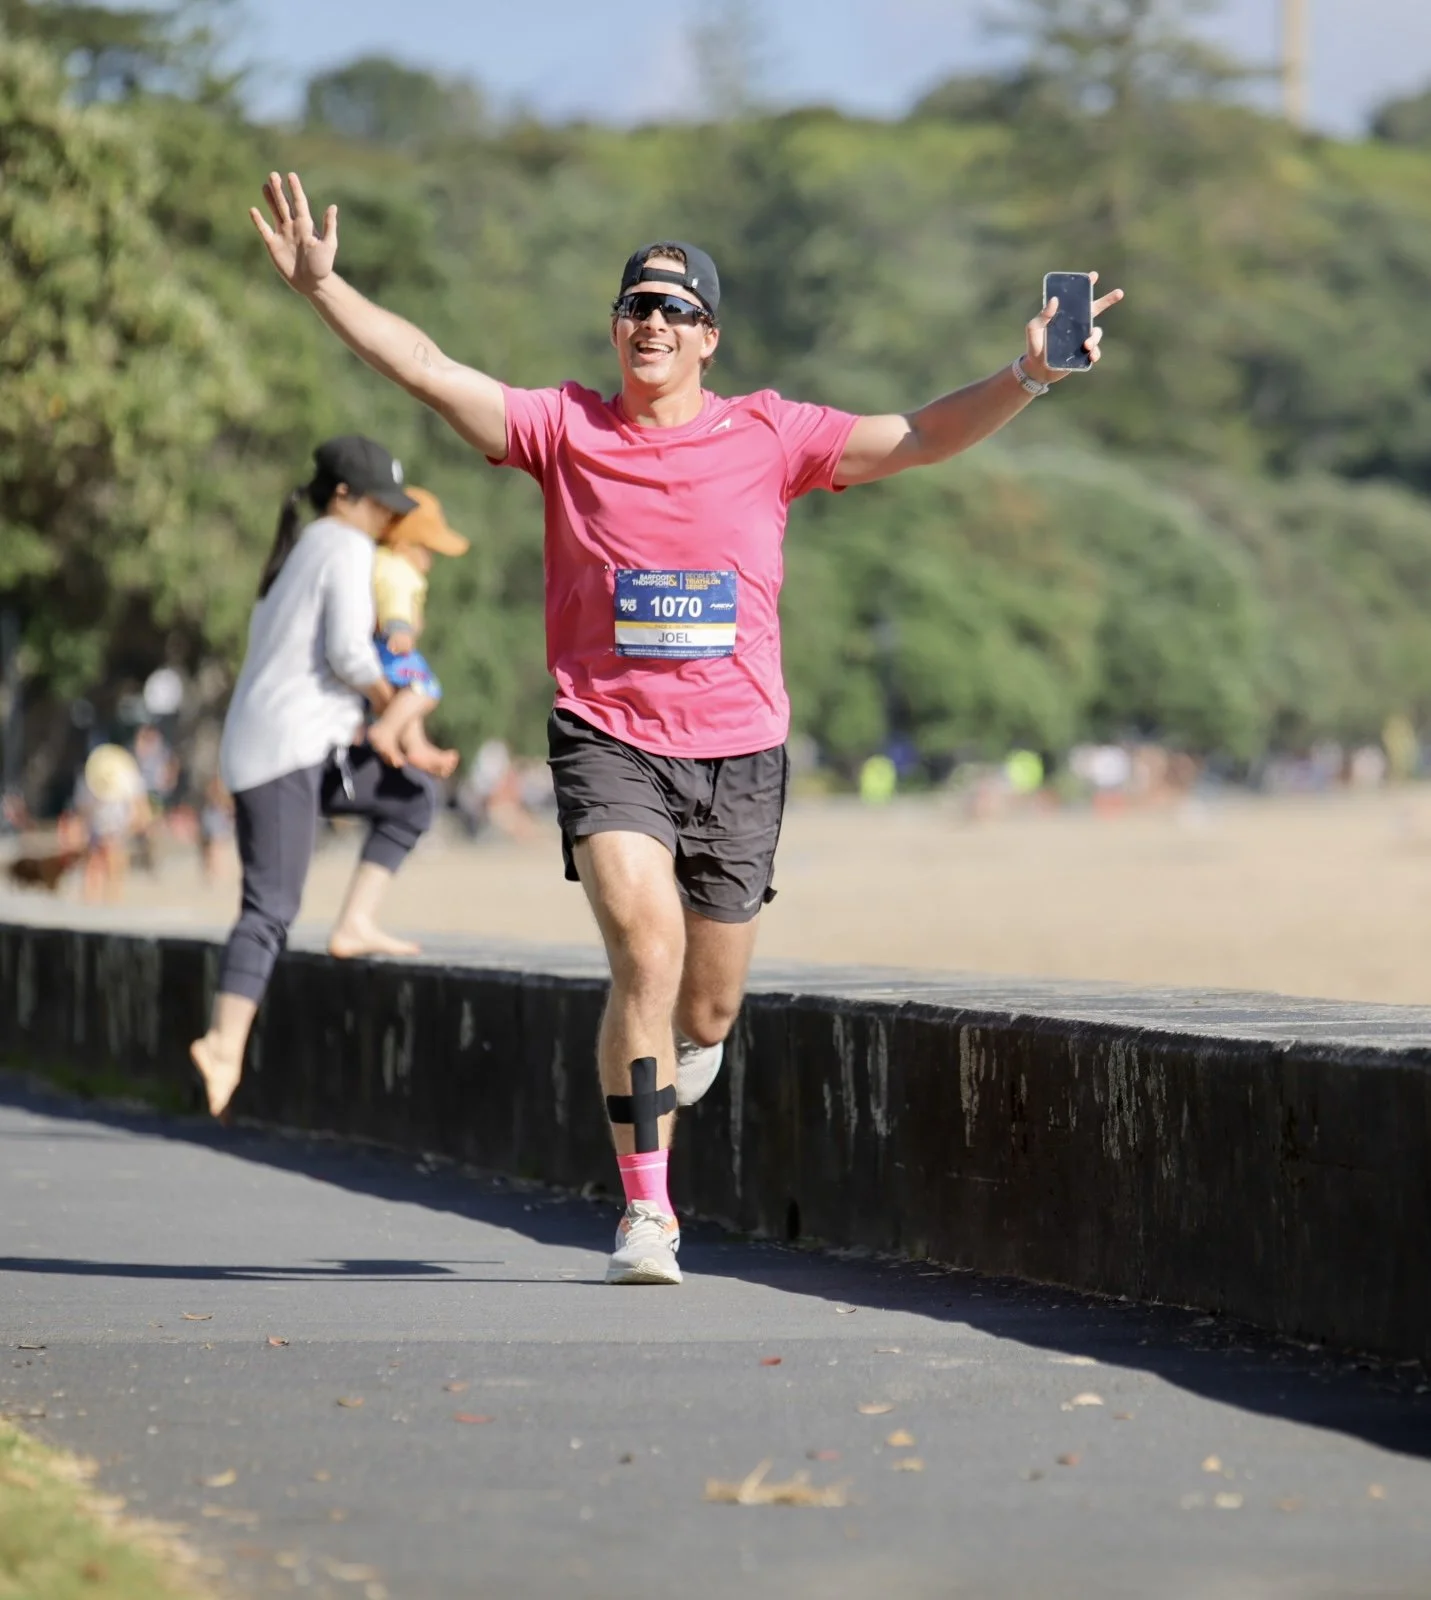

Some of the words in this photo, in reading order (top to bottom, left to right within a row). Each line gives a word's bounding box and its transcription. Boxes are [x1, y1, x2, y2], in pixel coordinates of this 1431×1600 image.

[668, 574, 677, 586] &
[650, 596, 702, 618] 1070
[658, 632, 692, 643] JOEL
